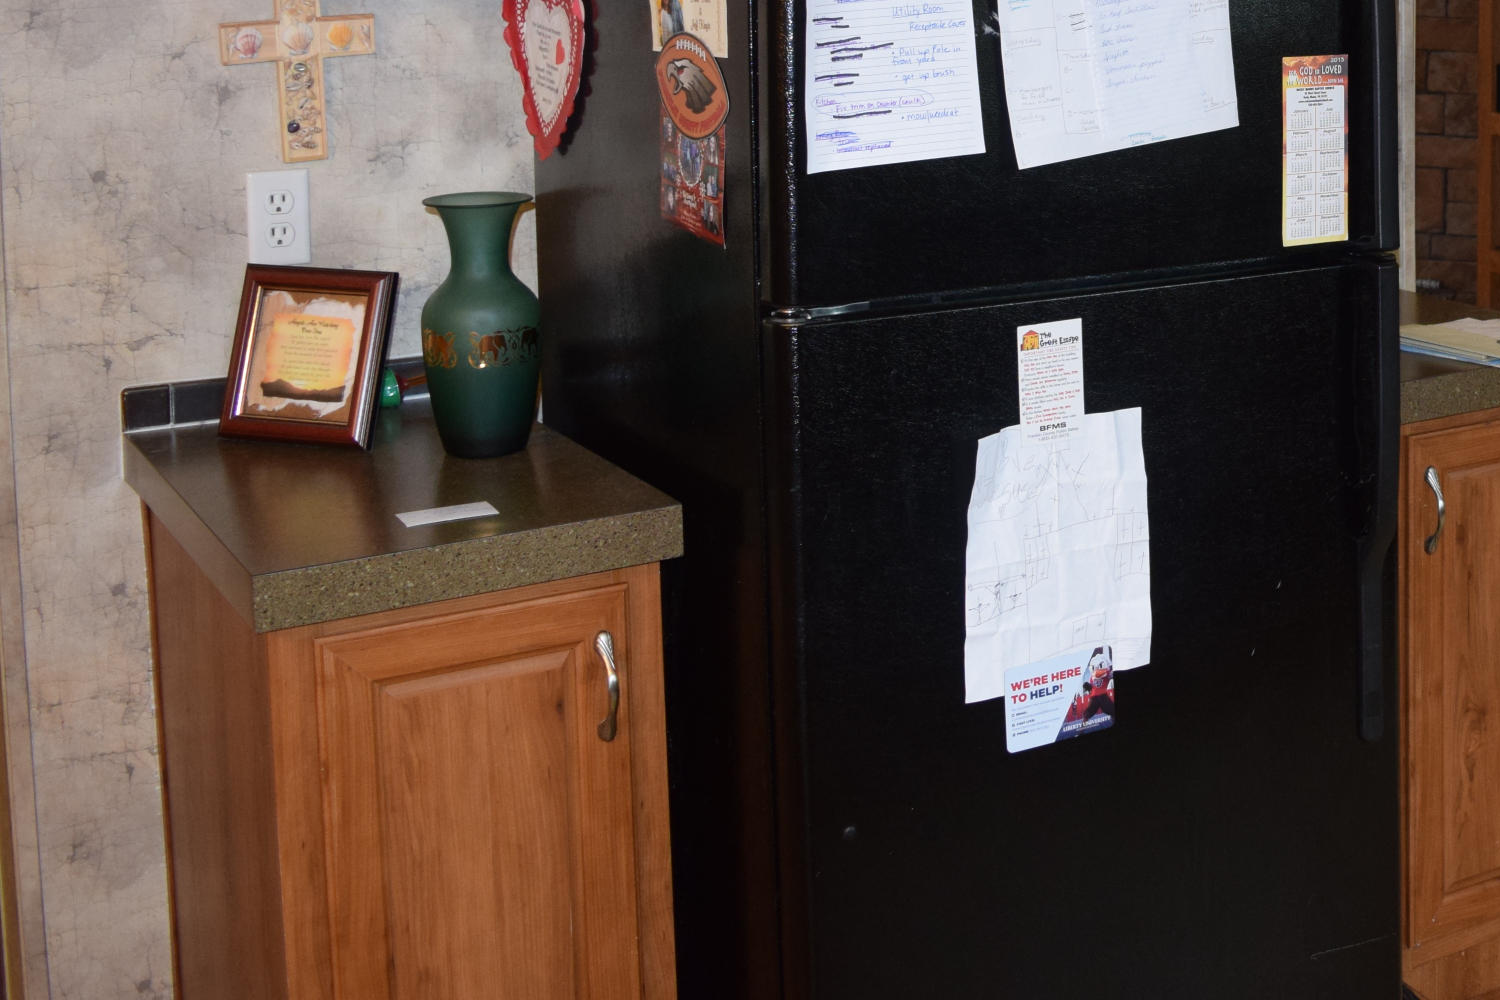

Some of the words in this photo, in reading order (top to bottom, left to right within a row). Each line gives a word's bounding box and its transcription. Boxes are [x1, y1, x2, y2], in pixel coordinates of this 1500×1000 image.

[922, 3, 944, 14] Room
[1299, 65, 1313, 75] GOD
[1321, 64, 1341, 74] LOVED
[1039, 421, 1066, 431] BFMS
[1011, 674, 1048, 691] WE'RE
[1050, 666, 1081, 681] HERE
[1011, 693, 1026, 704] TO
[1030, 684, 1063, 700] HELP!
[1062, 723, 1082, 732] LIBERTY
